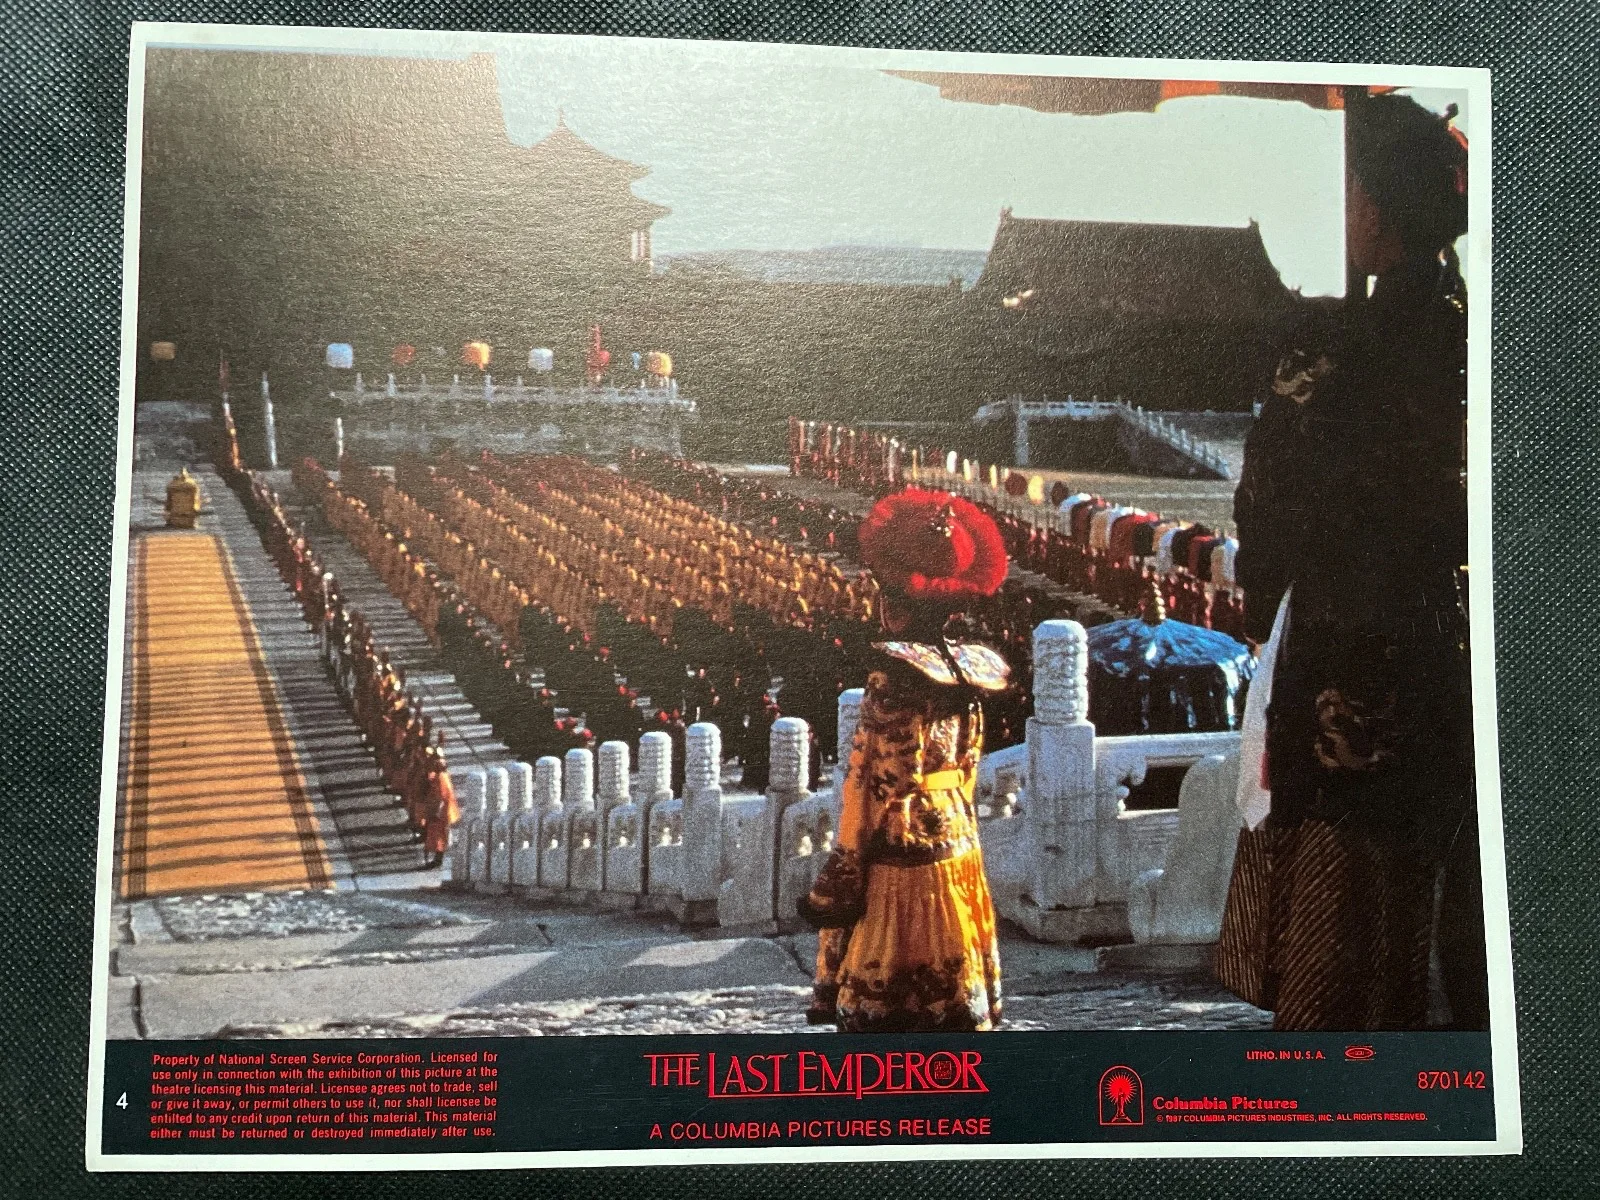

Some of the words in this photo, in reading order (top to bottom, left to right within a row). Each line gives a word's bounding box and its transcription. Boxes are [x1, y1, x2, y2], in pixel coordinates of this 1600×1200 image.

[153, 1054, 199, 1067] Property
[204, 1054, 214, 1064] of
[219, 1054, 264, 1065] National
[270, 1054, 306, 1064] Screen
[312, 1053, 352, 1064] Service
[357, 1053, 425, 1065] Corporation.
[431, 1052, 477, 1063] Licensed
[483, 1052, 498, 1062] for
[152, 1071, 171, 1080] use
[175, 1069, 198, 1081] only
[202, 1069, 213, 1079] in
[217, 1069, 275, 1079] connection
[280, 1068, 303, 1079] with
[307, 1068, 324, 1079] the
[328, 1068, 382, 1079] exhibition
[386, 1067, 396, 1078] of
[400, 1067, 420, 1078] this
[424, 1067, 462, 1079] picture
[466, 1067, 476, 1077] at
[480, 1066, 498, 1077] the
[643, 1053, 700, 1086] THE
[707, 1052, 788, 1098] LAST
[798, 1051, 990, 1099] EMPEROR
[1418, 1070, 1486, 1090] 870142
[151, 1084, 190, 1095] theatre
[193, 1083, 242, 1096] licensing
[245, 1083, 265, 1094] this
[269, 1083, 317, 1094] material.
[321, 1083, 367, 1094] Licensee
[371, 1084, 405, 1095] agrees
[409, 1082, 427, 1093] not
[430, 1082, 441, 1093] to
[443, 1081, 475, 1093] trade,
[478, 1081, 498, 1092] sell
[115, 1091, 129, 1110] 4
[151, 1100, 163, 1109] or
[166, 1099, 189, 1111] give
[192, 1098, 200, 1109] it
[203, 1099, 235, 1111] away,
[239, 1099, 250, 1109] or
[254, 1098, 290, 1110] permit
[292, 1097, 326, 1108] others
[330, 1098, 341, 1108] to
[345, 1098, 364, 1108] use
[368, 1097, 380, 1109] it,
[384, 1098, 402, 1108] nor
[406, 1096, 433, 1107] shall
[436, 1096, 480, 1107] licensee
[484, 1096, 498, 1107] be
[1152, 1096, 1228, 1111] Columbia
[1231, 1096, 1298, 1110] Pictures
[196, 1113, 206, 1124] to
[209, 1114, 228, 1126] any
[231, 1113, 262, 1124] credit
[266, 1114, 292, 1126] upon
[297, 1114, 329, 1124] return
[334, 1112, 345, 1123] of
[348, 1112, 368, 1123] this
[373, 1111, 421, 1123] material.
[425, 1111, 448, 1122] This
[452, 1110, 497, 1122] material
[1184, 1114, 1226, 1122] COLUMBIA
[1227, 1114, 1266, 1122] PICTURES
[1318, 1114, 1334, 1122] INC.
[1336, 1113, 1352, 1121] ALL
[1353, 1113, 1382, 1121] RIGHTS
[1384, 1112, 1428, 1121] RESERVED.
[150, 1127, 182, 1139] either
[189, 1128, 215, 1139] must
[222, 1127, 235, 1138] be
[241, 1127, 287, 1138] returned
[293, 1129, 305, 1138] or
[311, 1127, 363, 1140] destroyed
[370, 1126, 437, 1139] immediately
[441, 1126, 467, 1137] after
[473, 1127, 496, 1137] use.
[650, 1123, 663, 1140] A
[670, 1121, 781, 1140] COLUMBIA
[787, 1119, 892, 1139] PICTURES
[898, 1118, 991, 1137] RELEASE
